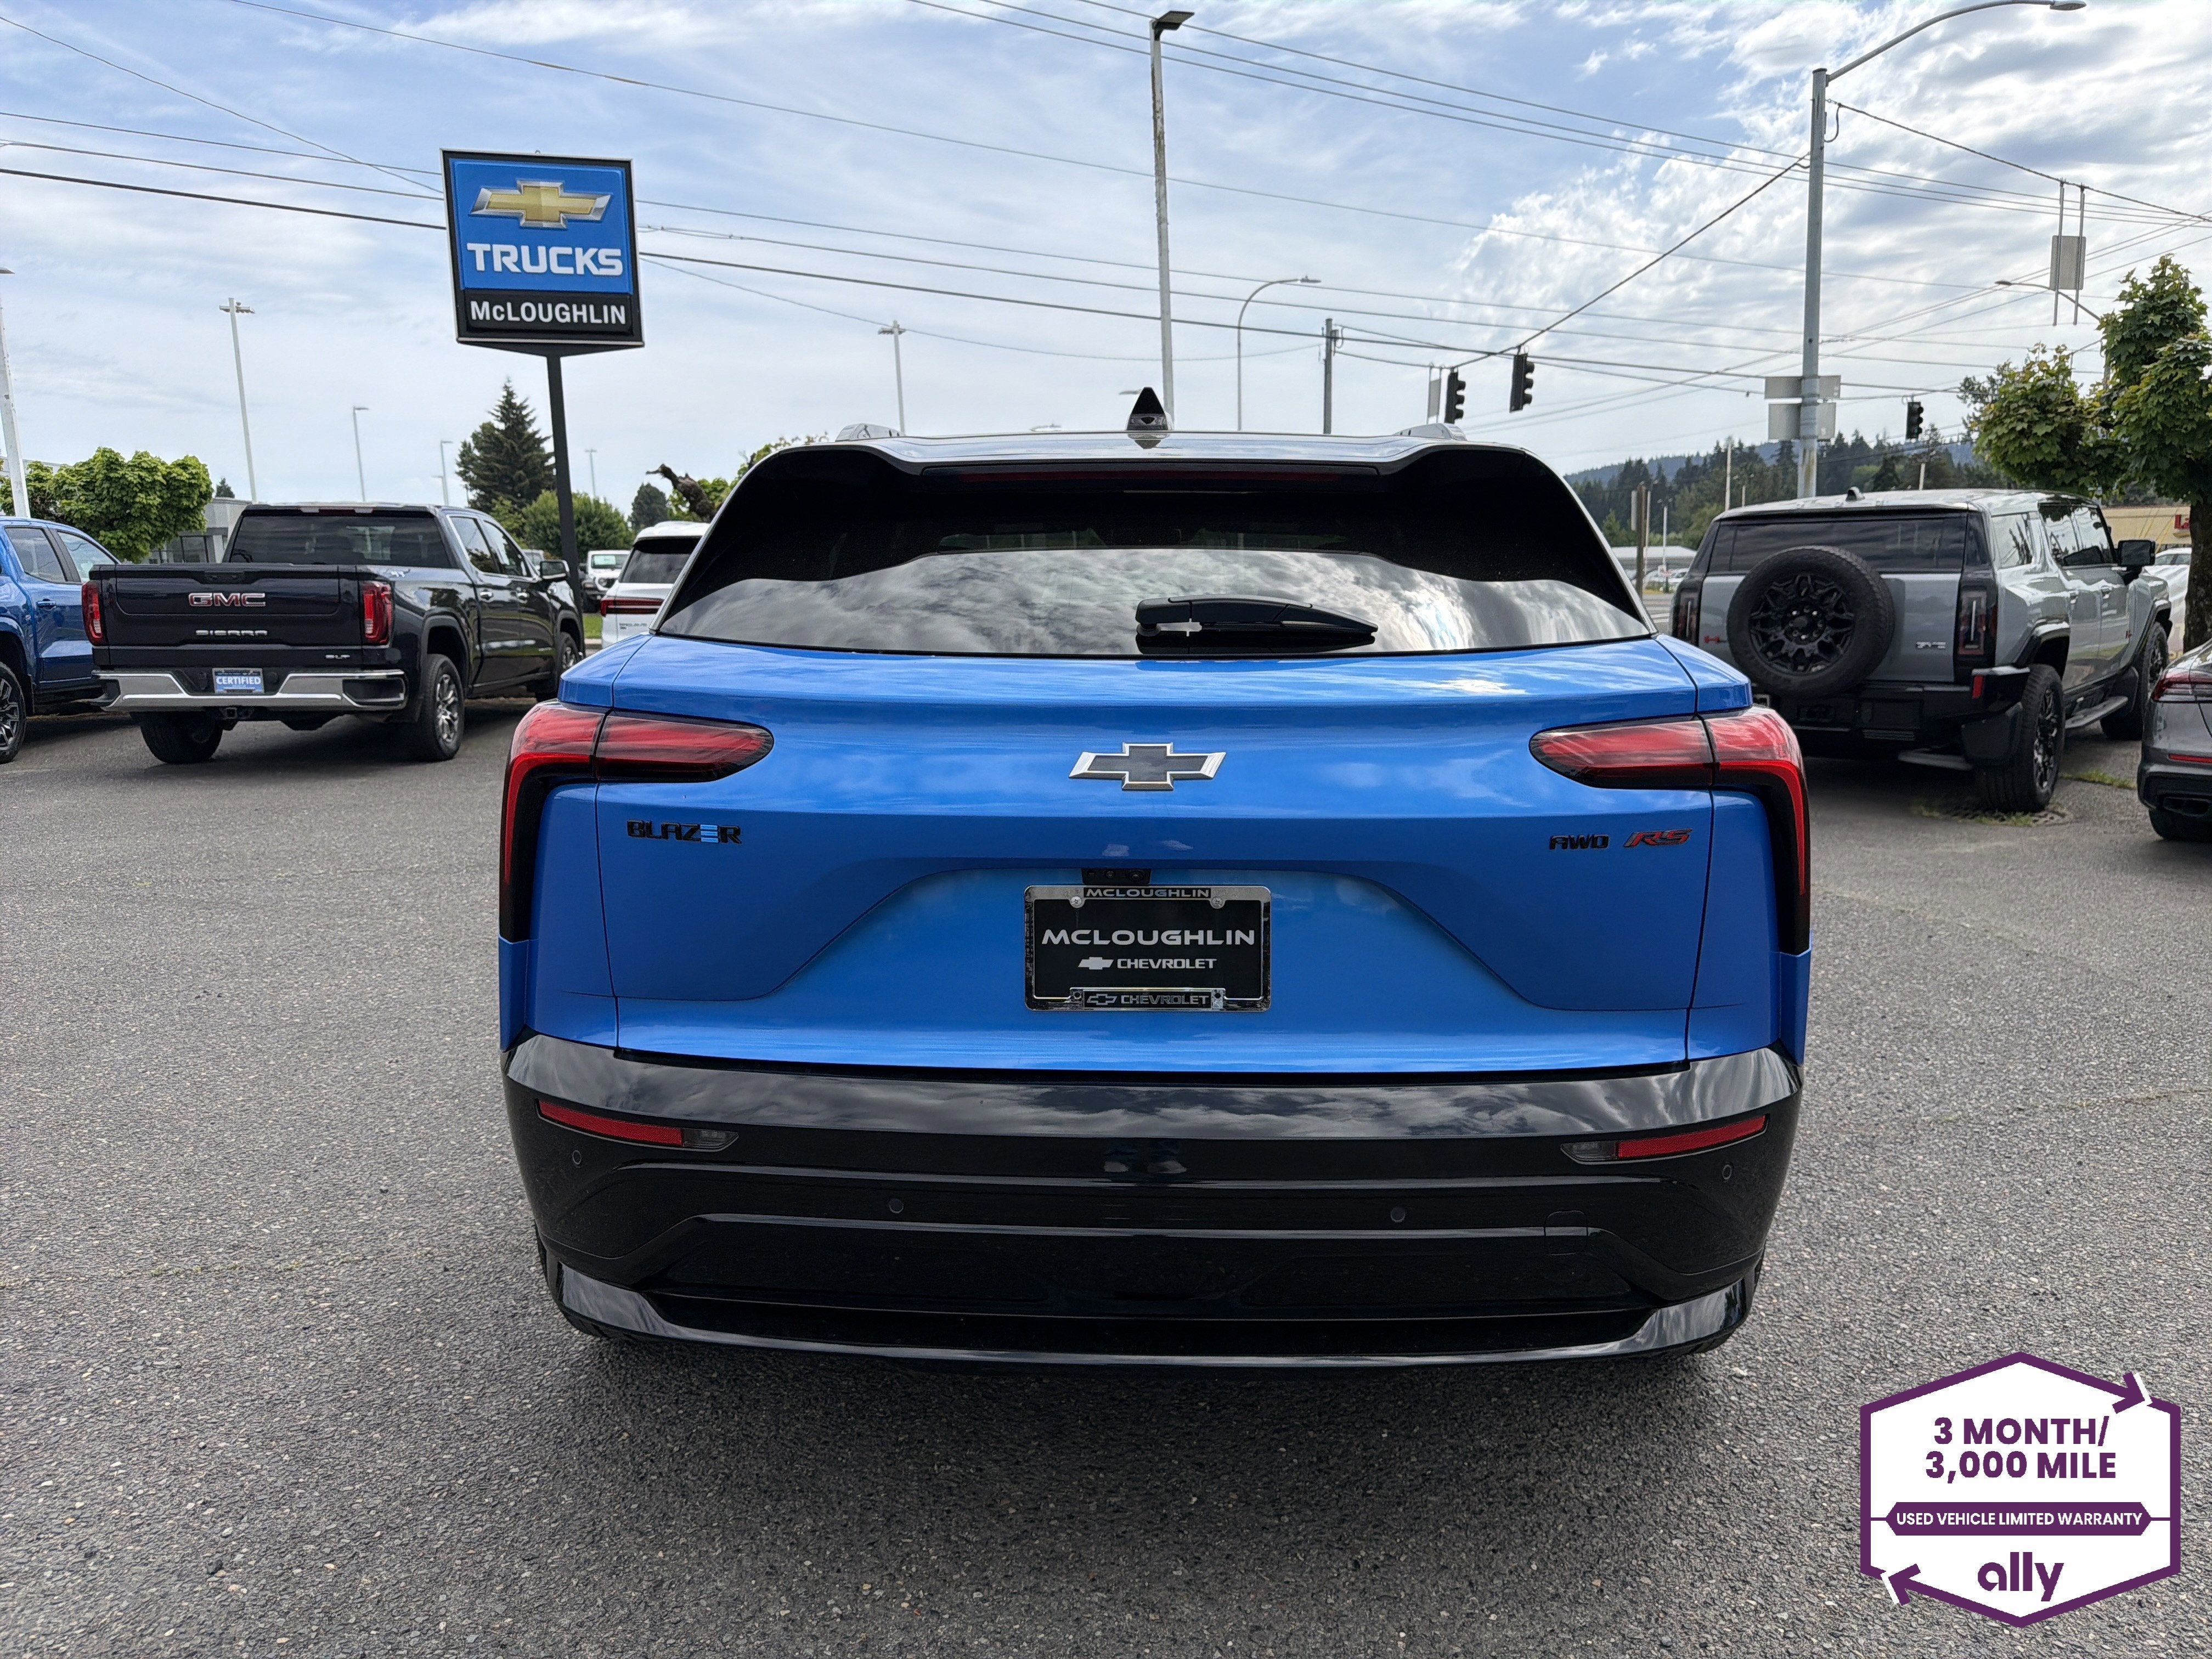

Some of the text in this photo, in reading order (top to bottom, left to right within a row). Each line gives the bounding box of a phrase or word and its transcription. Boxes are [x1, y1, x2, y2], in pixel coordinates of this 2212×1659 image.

[467, 243, 623, 276] TRUCKS
[471, 301, 625, 324] McLOUGHLIN
[189, 592, 266, 606] GMC
[216, 676, 261, 685] CERTIFIED
[627, 820, 742, 844] BLAZER
[1549, 828, 1692, 850] AWD RS
[1086, 889, 1209, 898] MCLOUGHLIN
[1042, 929, 1255, 945] MCLOUGHLIN
[1117, 958, 1217, 969] CHEVROLET
[1121, 995, 1209, 1005] CHEVROLET
